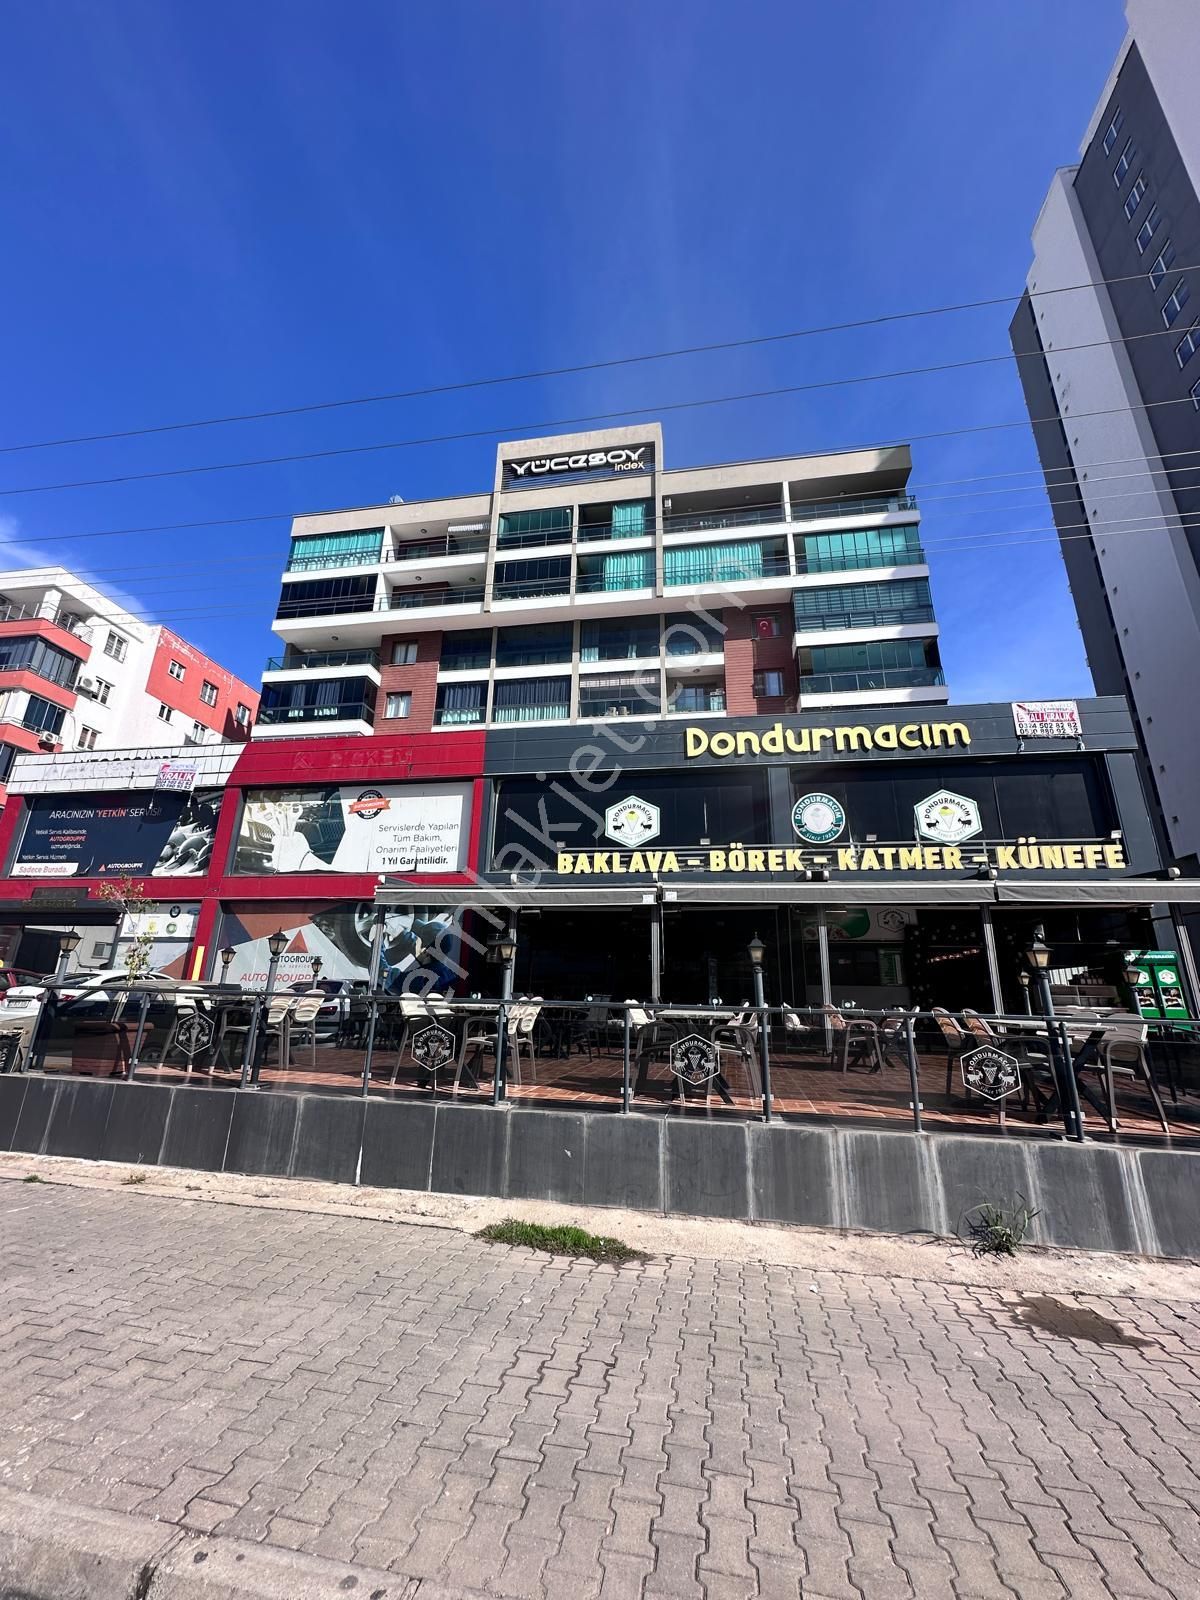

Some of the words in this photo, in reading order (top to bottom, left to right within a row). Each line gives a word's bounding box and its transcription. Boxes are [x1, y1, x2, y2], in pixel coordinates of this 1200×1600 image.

[615, 461, 645, 472] index
[685, 722, 972, 758] Dondurmacım
[49, 808, 94, 819] ARACINIZIN
[612, 804, 653, 822] DONDURMACIM
[794, 796, 842, 819] DONDURMACIM
[924, 798, 971, 819] DONDURMACIM
[378, 824, 426, 832] Servislerde
[428, 822, 459, 831] Yapılan
[376, 846, 408, 854] Onarım
[558, 851, 680, 874] BAKLAVA
[709, 842, 806, 872] BÖREK
[837, 846, 964, 871] KATMER
[996, 836, 1126, 869] KÜNEFE
[382, 857, 386, 865] 1
[388, 856, 398, 864] Yıl
[18, 866, 42, 874] Sadece
[968, 1052, 1012, 1072] DONDURMACIM
